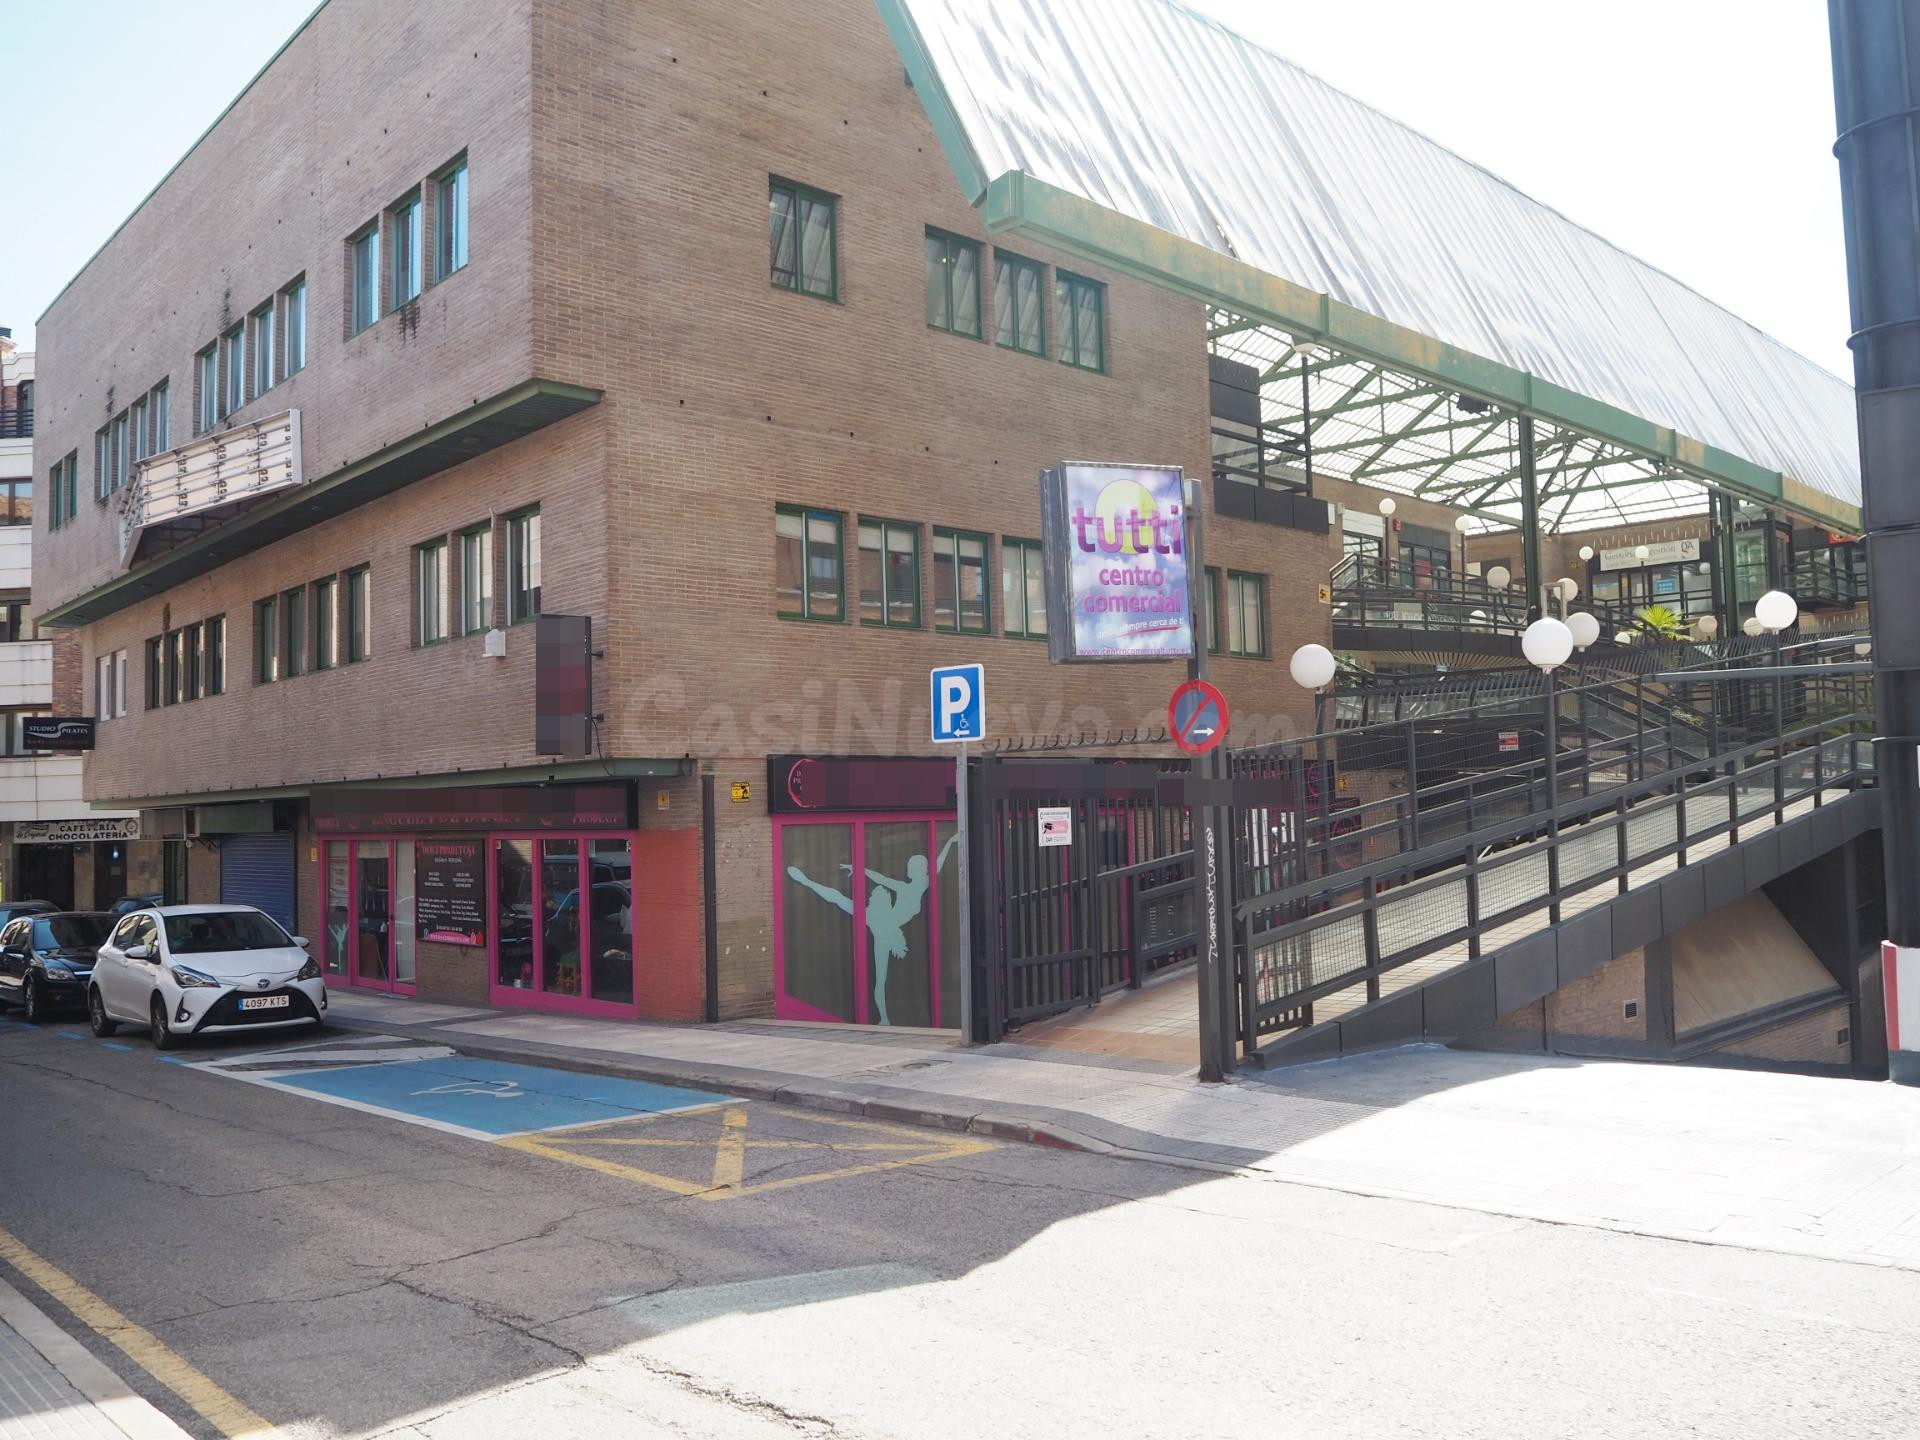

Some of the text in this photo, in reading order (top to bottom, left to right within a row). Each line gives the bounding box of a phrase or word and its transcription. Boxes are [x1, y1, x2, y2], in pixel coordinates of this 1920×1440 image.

[1072, 505, 1182, 554] tutti
[1098, 566, 1164, 587] centro
[1083, 589, 1182, 613] comercial
[1149, 618, 1168, 627] cerca
[1169, 617, 1179, 626] de
[941, 676, 971, 734] P
[245, 997, 287, 1008] 4097 KTS
